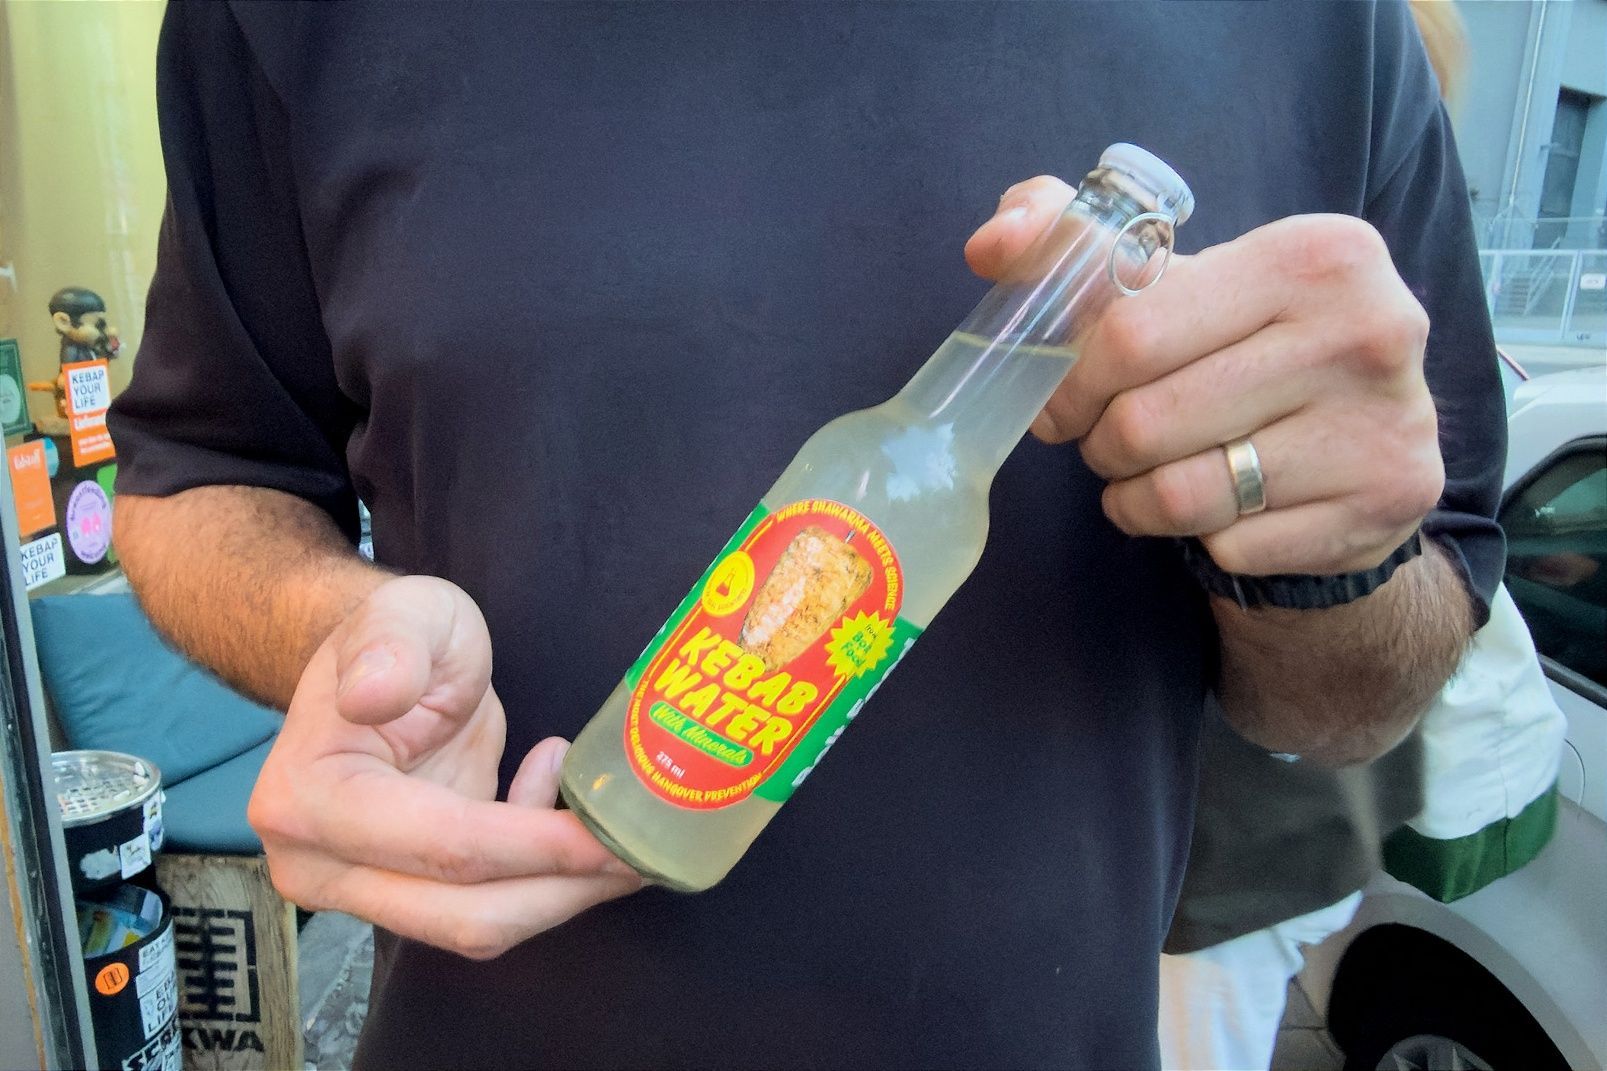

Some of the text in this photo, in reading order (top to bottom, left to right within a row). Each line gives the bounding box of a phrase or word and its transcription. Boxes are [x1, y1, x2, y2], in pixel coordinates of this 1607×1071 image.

[72, 370, 104, 384] KEBAP
[73, 384, 101, 396] YOUR
[75, 396, 96, 409] LIFE
[776, 500, 810, 523] WHERE
[21, 537, 58, 561] KEBAP
[22, 552, 55, 573] YOUR
[25, 568, 48, 586] LIFE
[679, 626, 819, 715] KEBAB
[654, 658, 793, 756] WATER
[653, 704, 748, 765] With Minerals
[652, 771, 703, 801] HANGOVER
